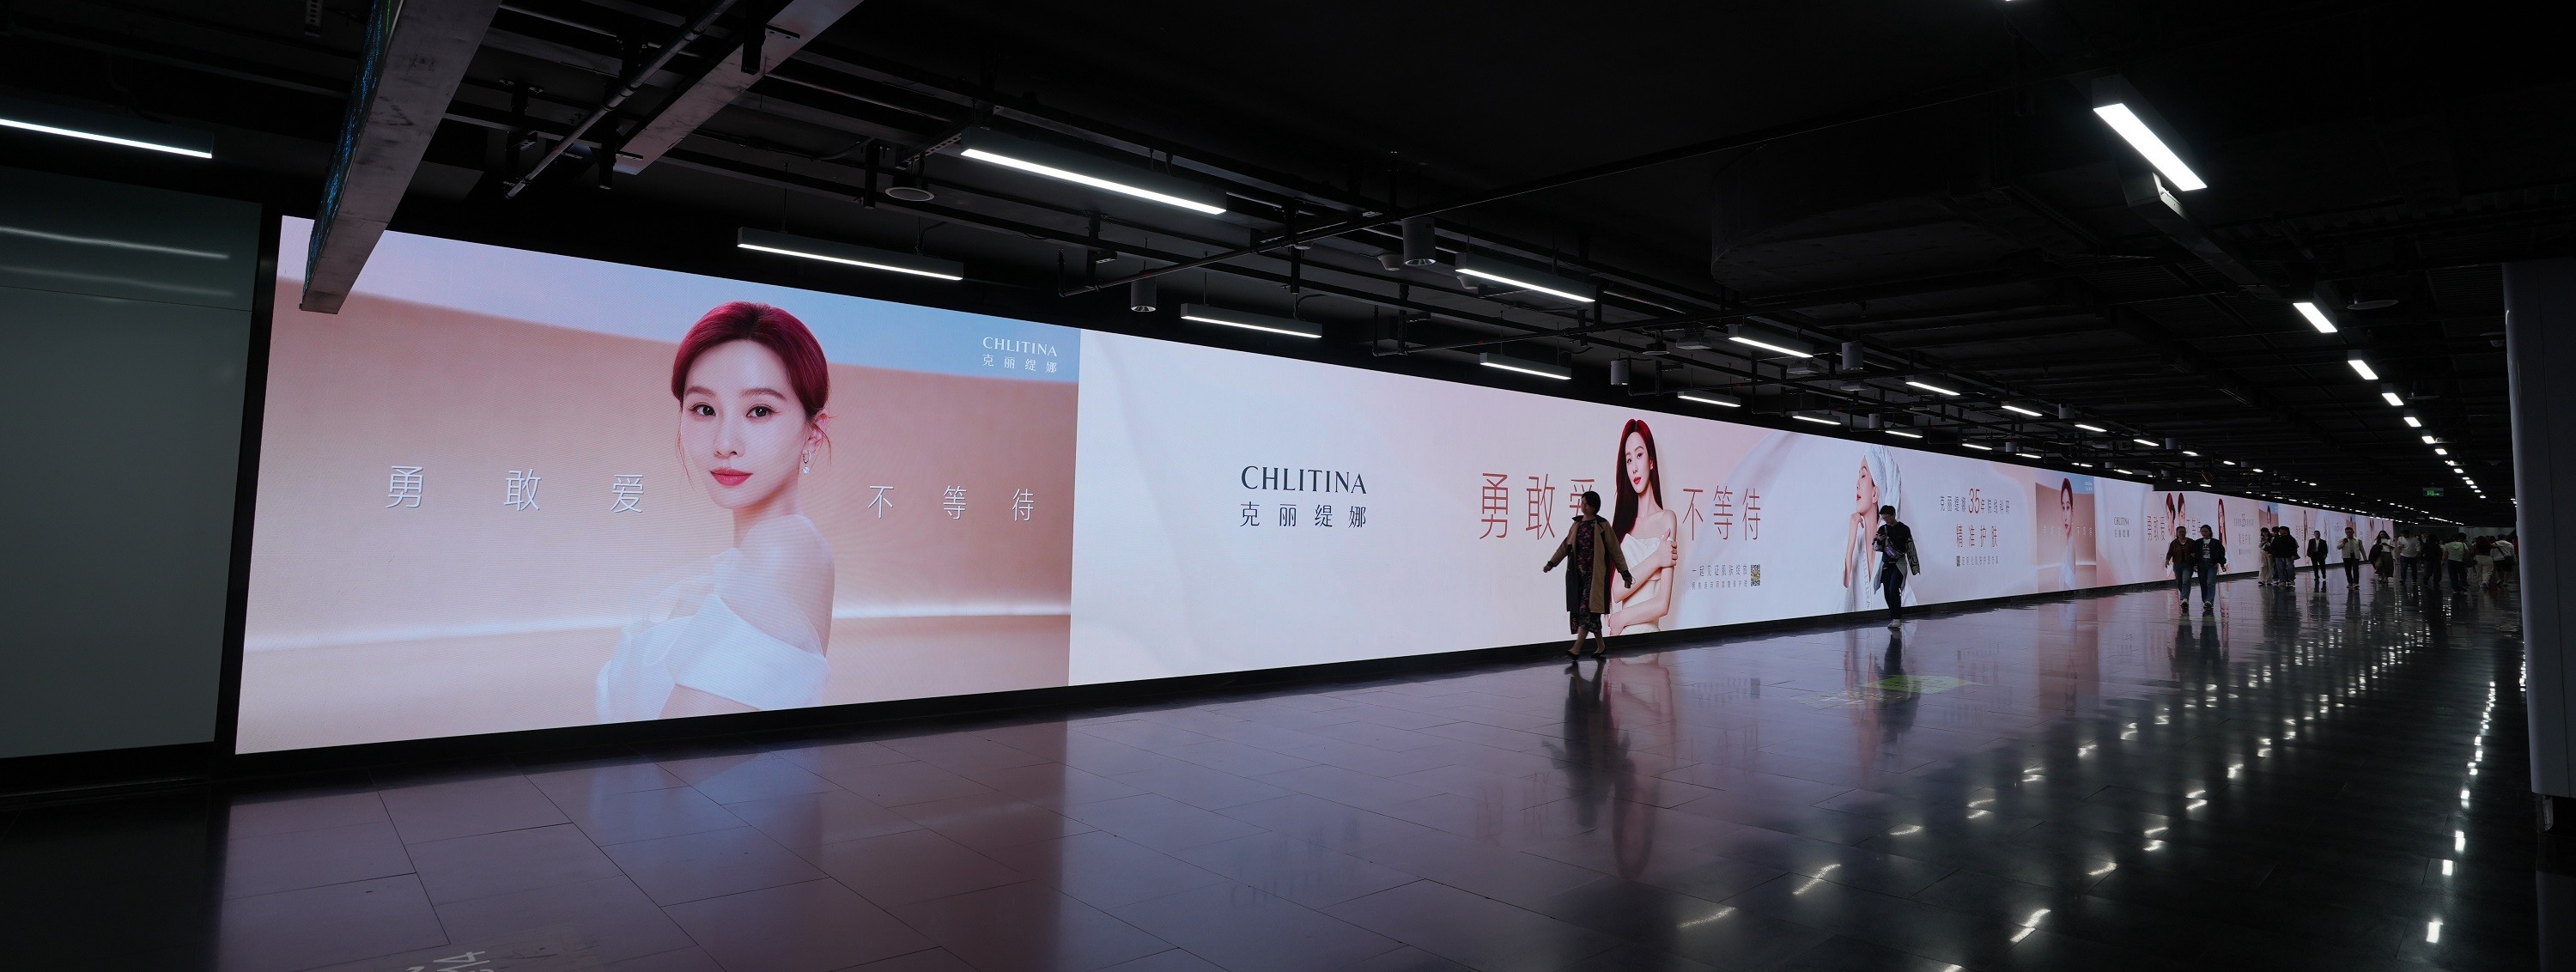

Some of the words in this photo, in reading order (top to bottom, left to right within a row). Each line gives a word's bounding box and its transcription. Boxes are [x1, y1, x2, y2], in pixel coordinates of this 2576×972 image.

[982, 337, 1058, 357] CHLITINA
[982, 353, 1058, 374] 克丽缇娜
[1241, 465, 1367, 495] CHLITINA
[1241, 501, 1367, 529] 克丽缇娜
[1682, 485, 1762, 542] 不等待
